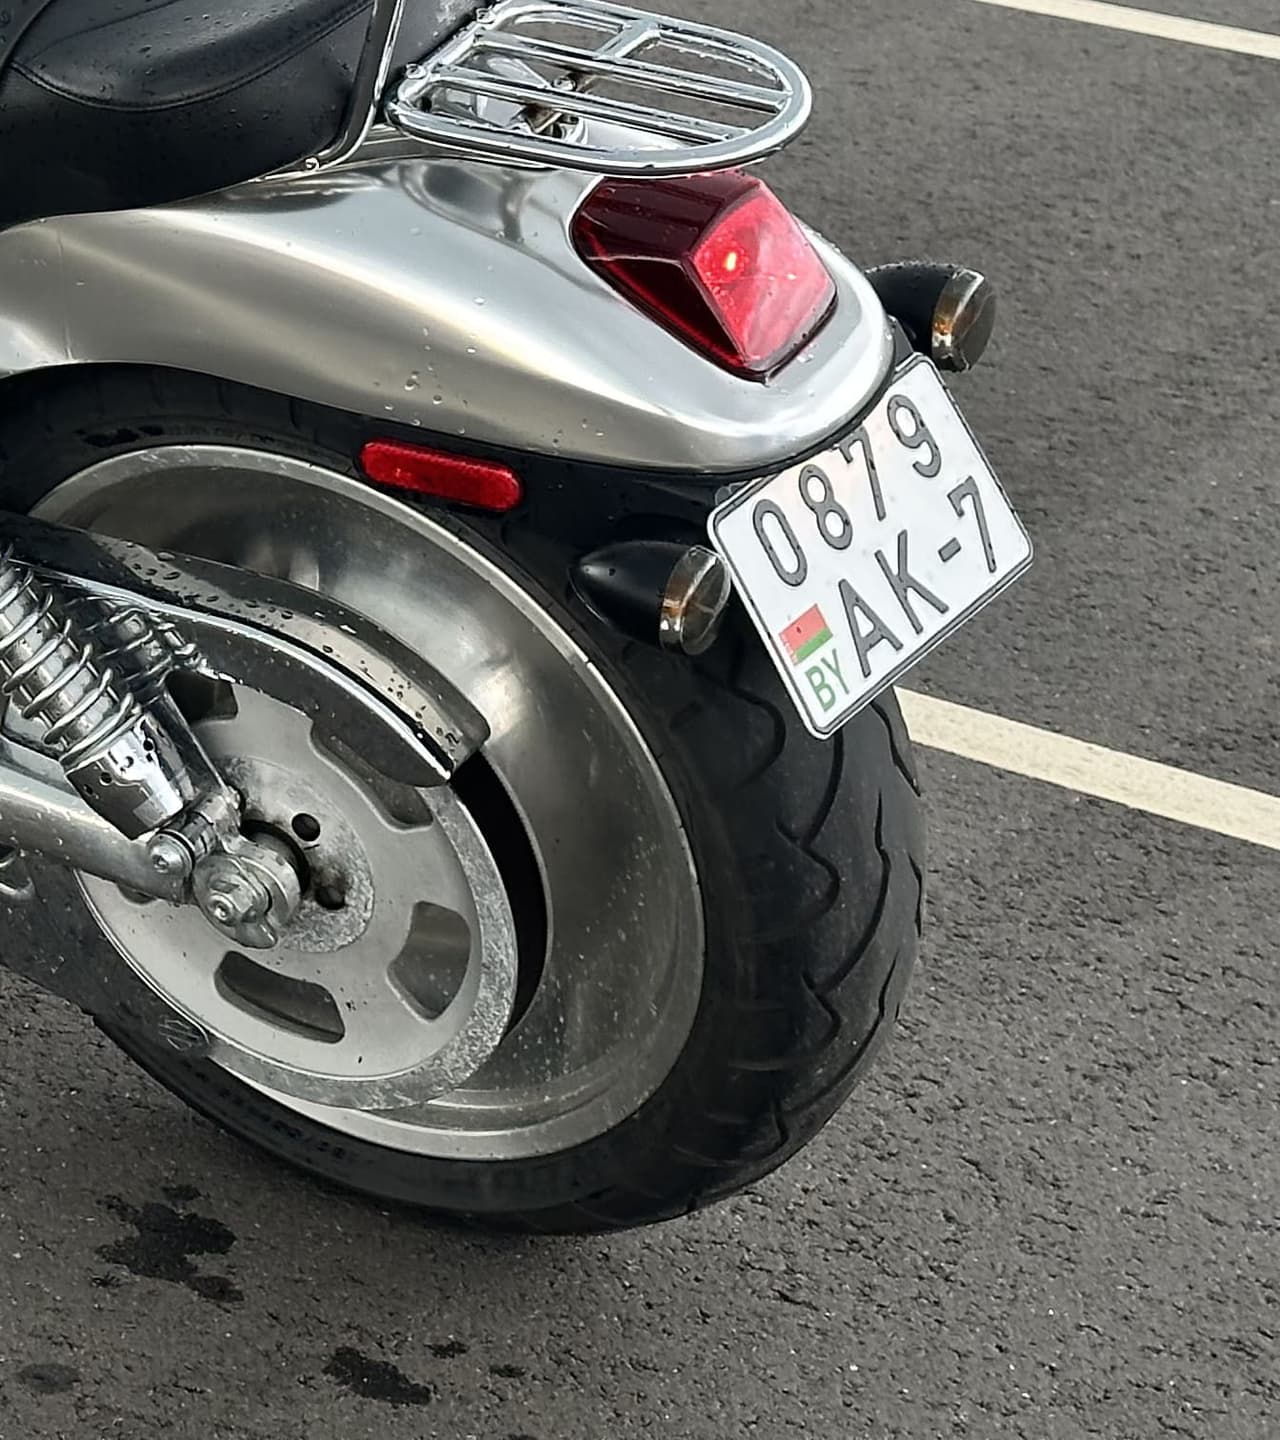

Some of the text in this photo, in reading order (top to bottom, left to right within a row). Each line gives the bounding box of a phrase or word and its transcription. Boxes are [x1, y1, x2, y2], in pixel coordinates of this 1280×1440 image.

[752, 394, 942, 587] 0879
[837, 475, 997, 678] AK-7
[804, 648, 850, 712] BY
